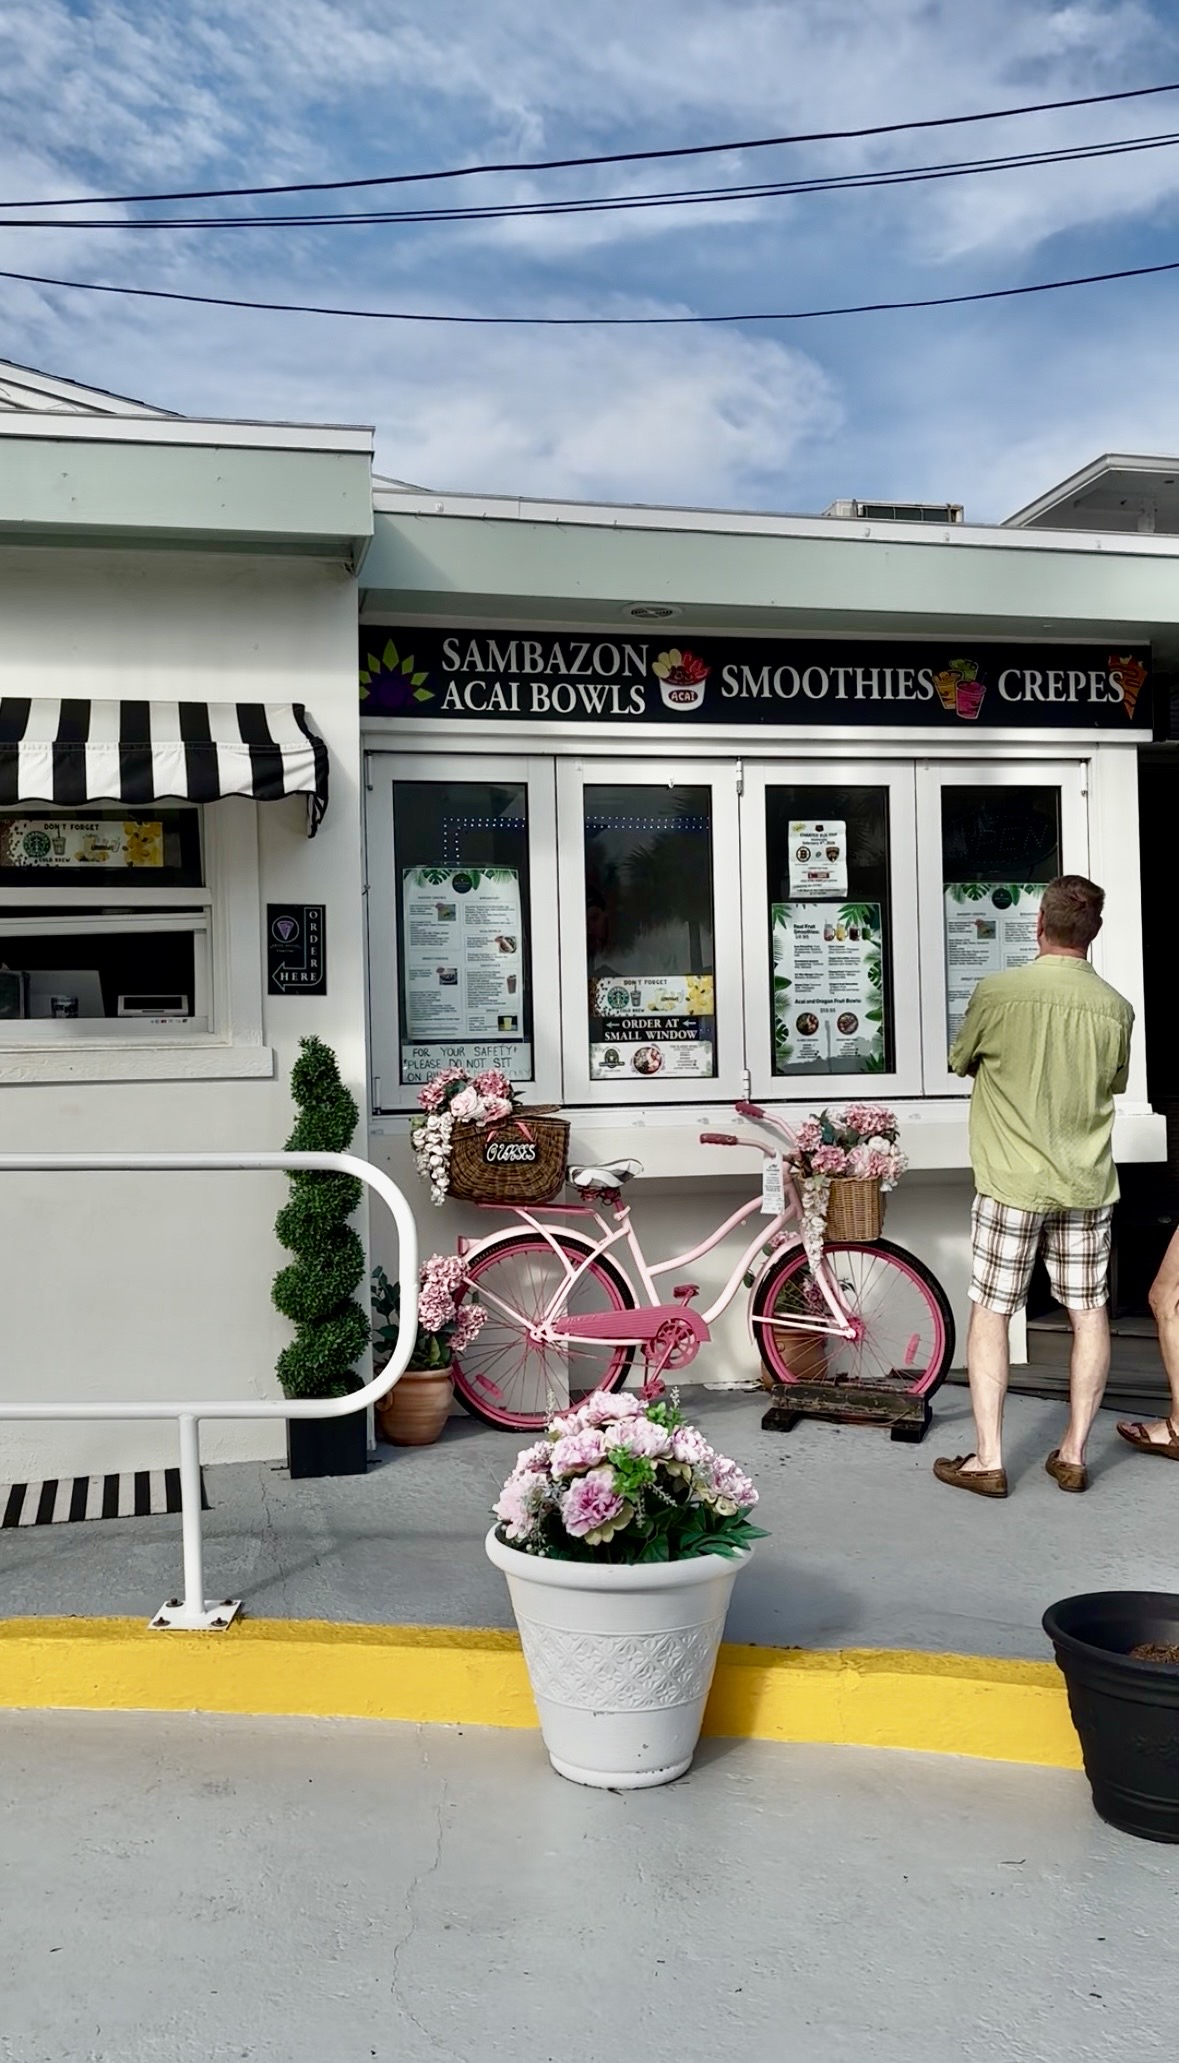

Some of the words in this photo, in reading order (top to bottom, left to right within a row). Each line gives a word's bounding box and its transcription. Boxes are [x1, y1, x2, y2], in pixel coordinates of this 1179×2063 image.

[440, 637, 649, 677] SAMBAZON
[721, 664, 935, 700] SMOOTHIES
[998, 669, 1126, 703] CREPES
[441, 680, 521, 712] ACAI
[529, 682, 646, 715] BOWLS
[670, 690, 696, 702] ACAI
[70, 823, 99, 831] FORGET
[309, 910, 319, 968] ORDER
[280, 972, 317, 981] HERE
[622, 1019, 662, 1029] ORDER
[665, 1018, 679, 1028] AT
[604, 1031, 643, 1041] SMALL
[645, 1029, 697, 1040] WINDOW
[412, 1047, 431, 1057] FOR
[440, 1046, 466, 1057] YOUR
[449, 1058, 463, 1067] DO
[466, 1058, 486, 1068] NOT
[493, 1057, 512, 1068] SIT
[407, 1072, 421, 1082] ON
